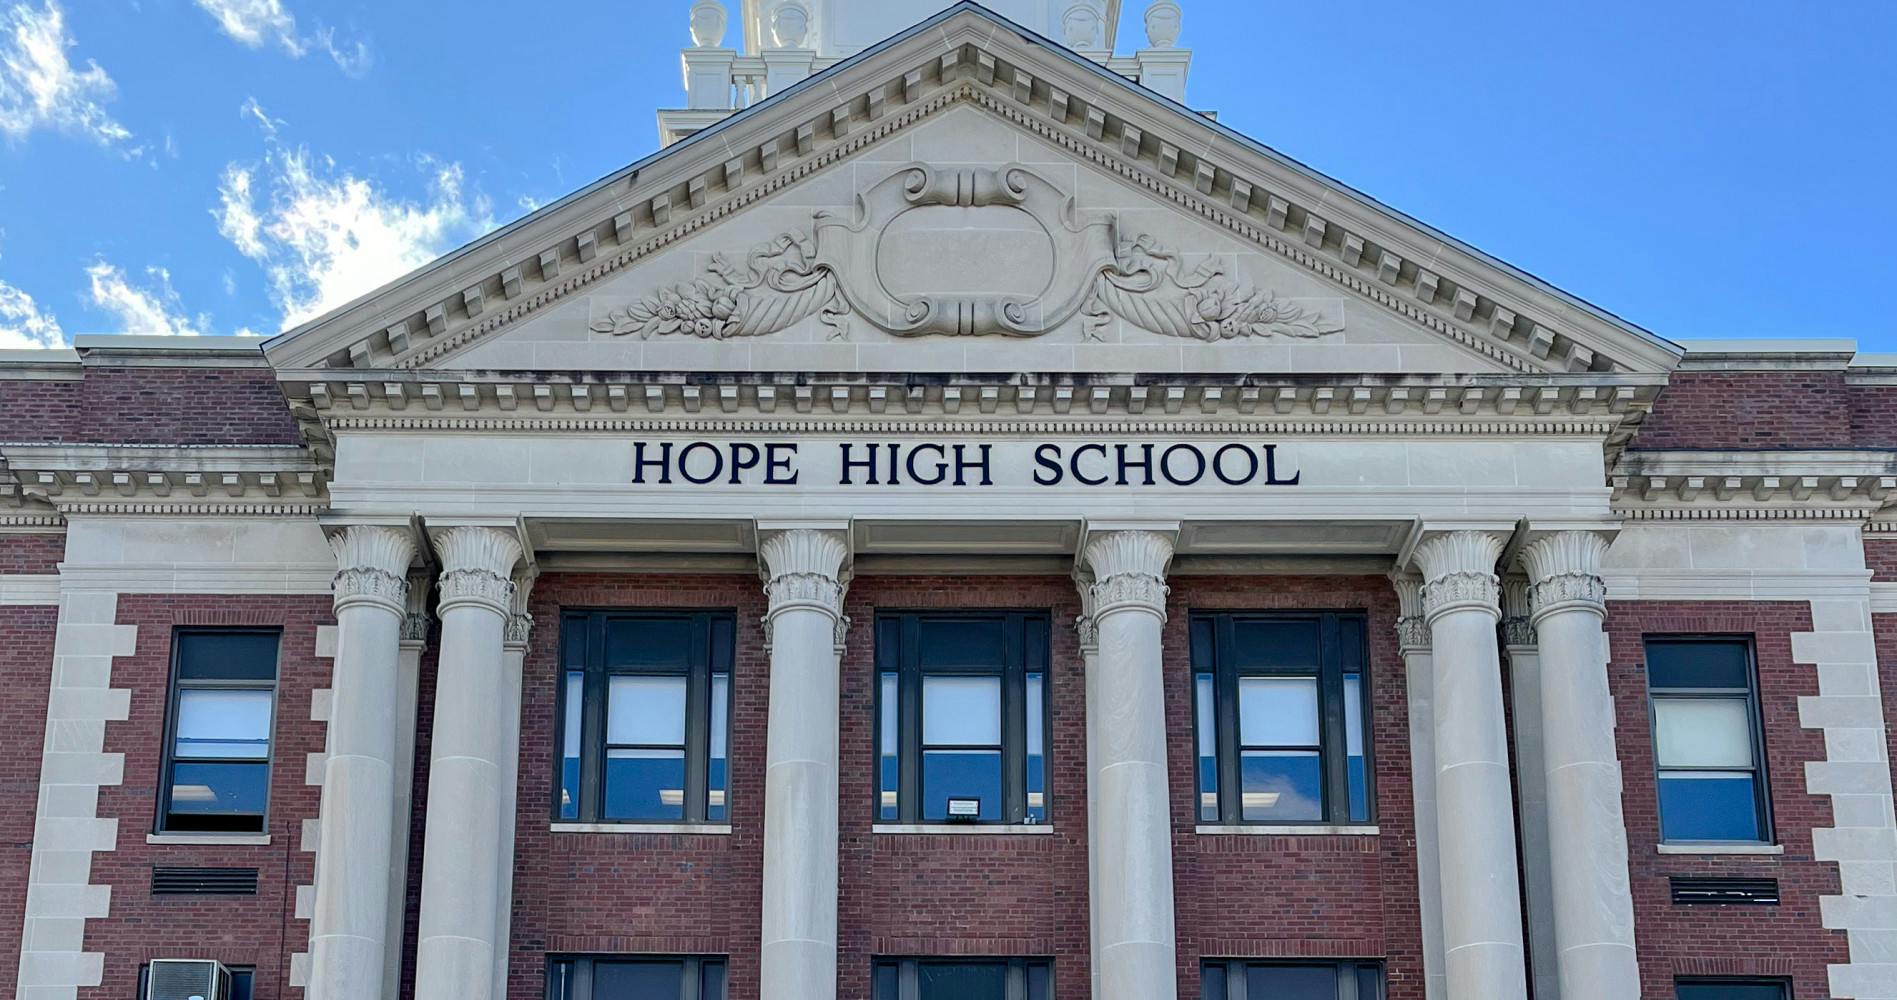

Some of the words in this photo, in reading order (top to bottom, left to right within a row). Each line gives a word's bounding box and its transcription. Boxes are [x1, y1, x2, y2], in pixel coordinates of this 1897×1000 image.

[632, 441, 799, 486] HOPE
[839, 443, 993, 487] HIGH
[1033, 443, 1301, 487] SCHOOL
